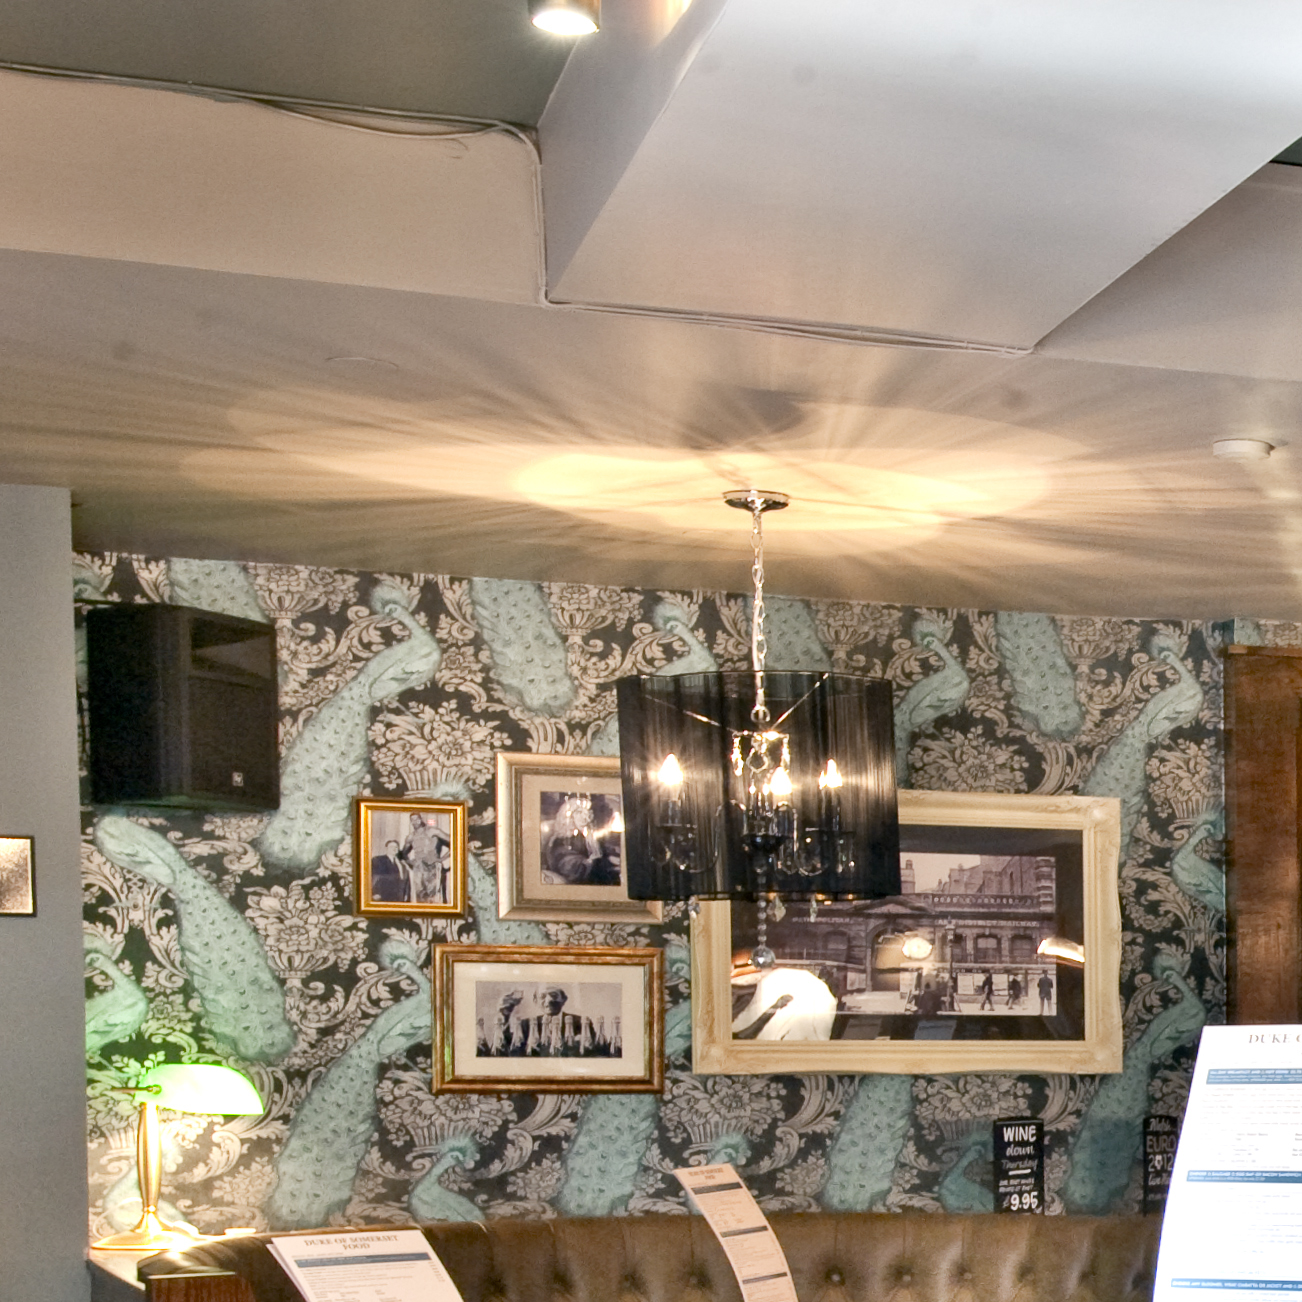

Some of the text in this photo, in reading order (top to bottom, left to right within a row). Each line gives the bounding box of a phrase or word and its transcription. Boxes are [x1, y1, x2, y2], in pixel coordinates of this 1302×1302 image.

[1248, 1033, 1291, 1044] DUKE
[1003, 1125, 1037, 1142] WINE
[1146, 1135, 1177, 1152] EURO
[1006, 1144, 1034, 1156] down
[303, 1238, 333, 1246] DUKE
[349, 1234, 399, 1243] SOMERSET
